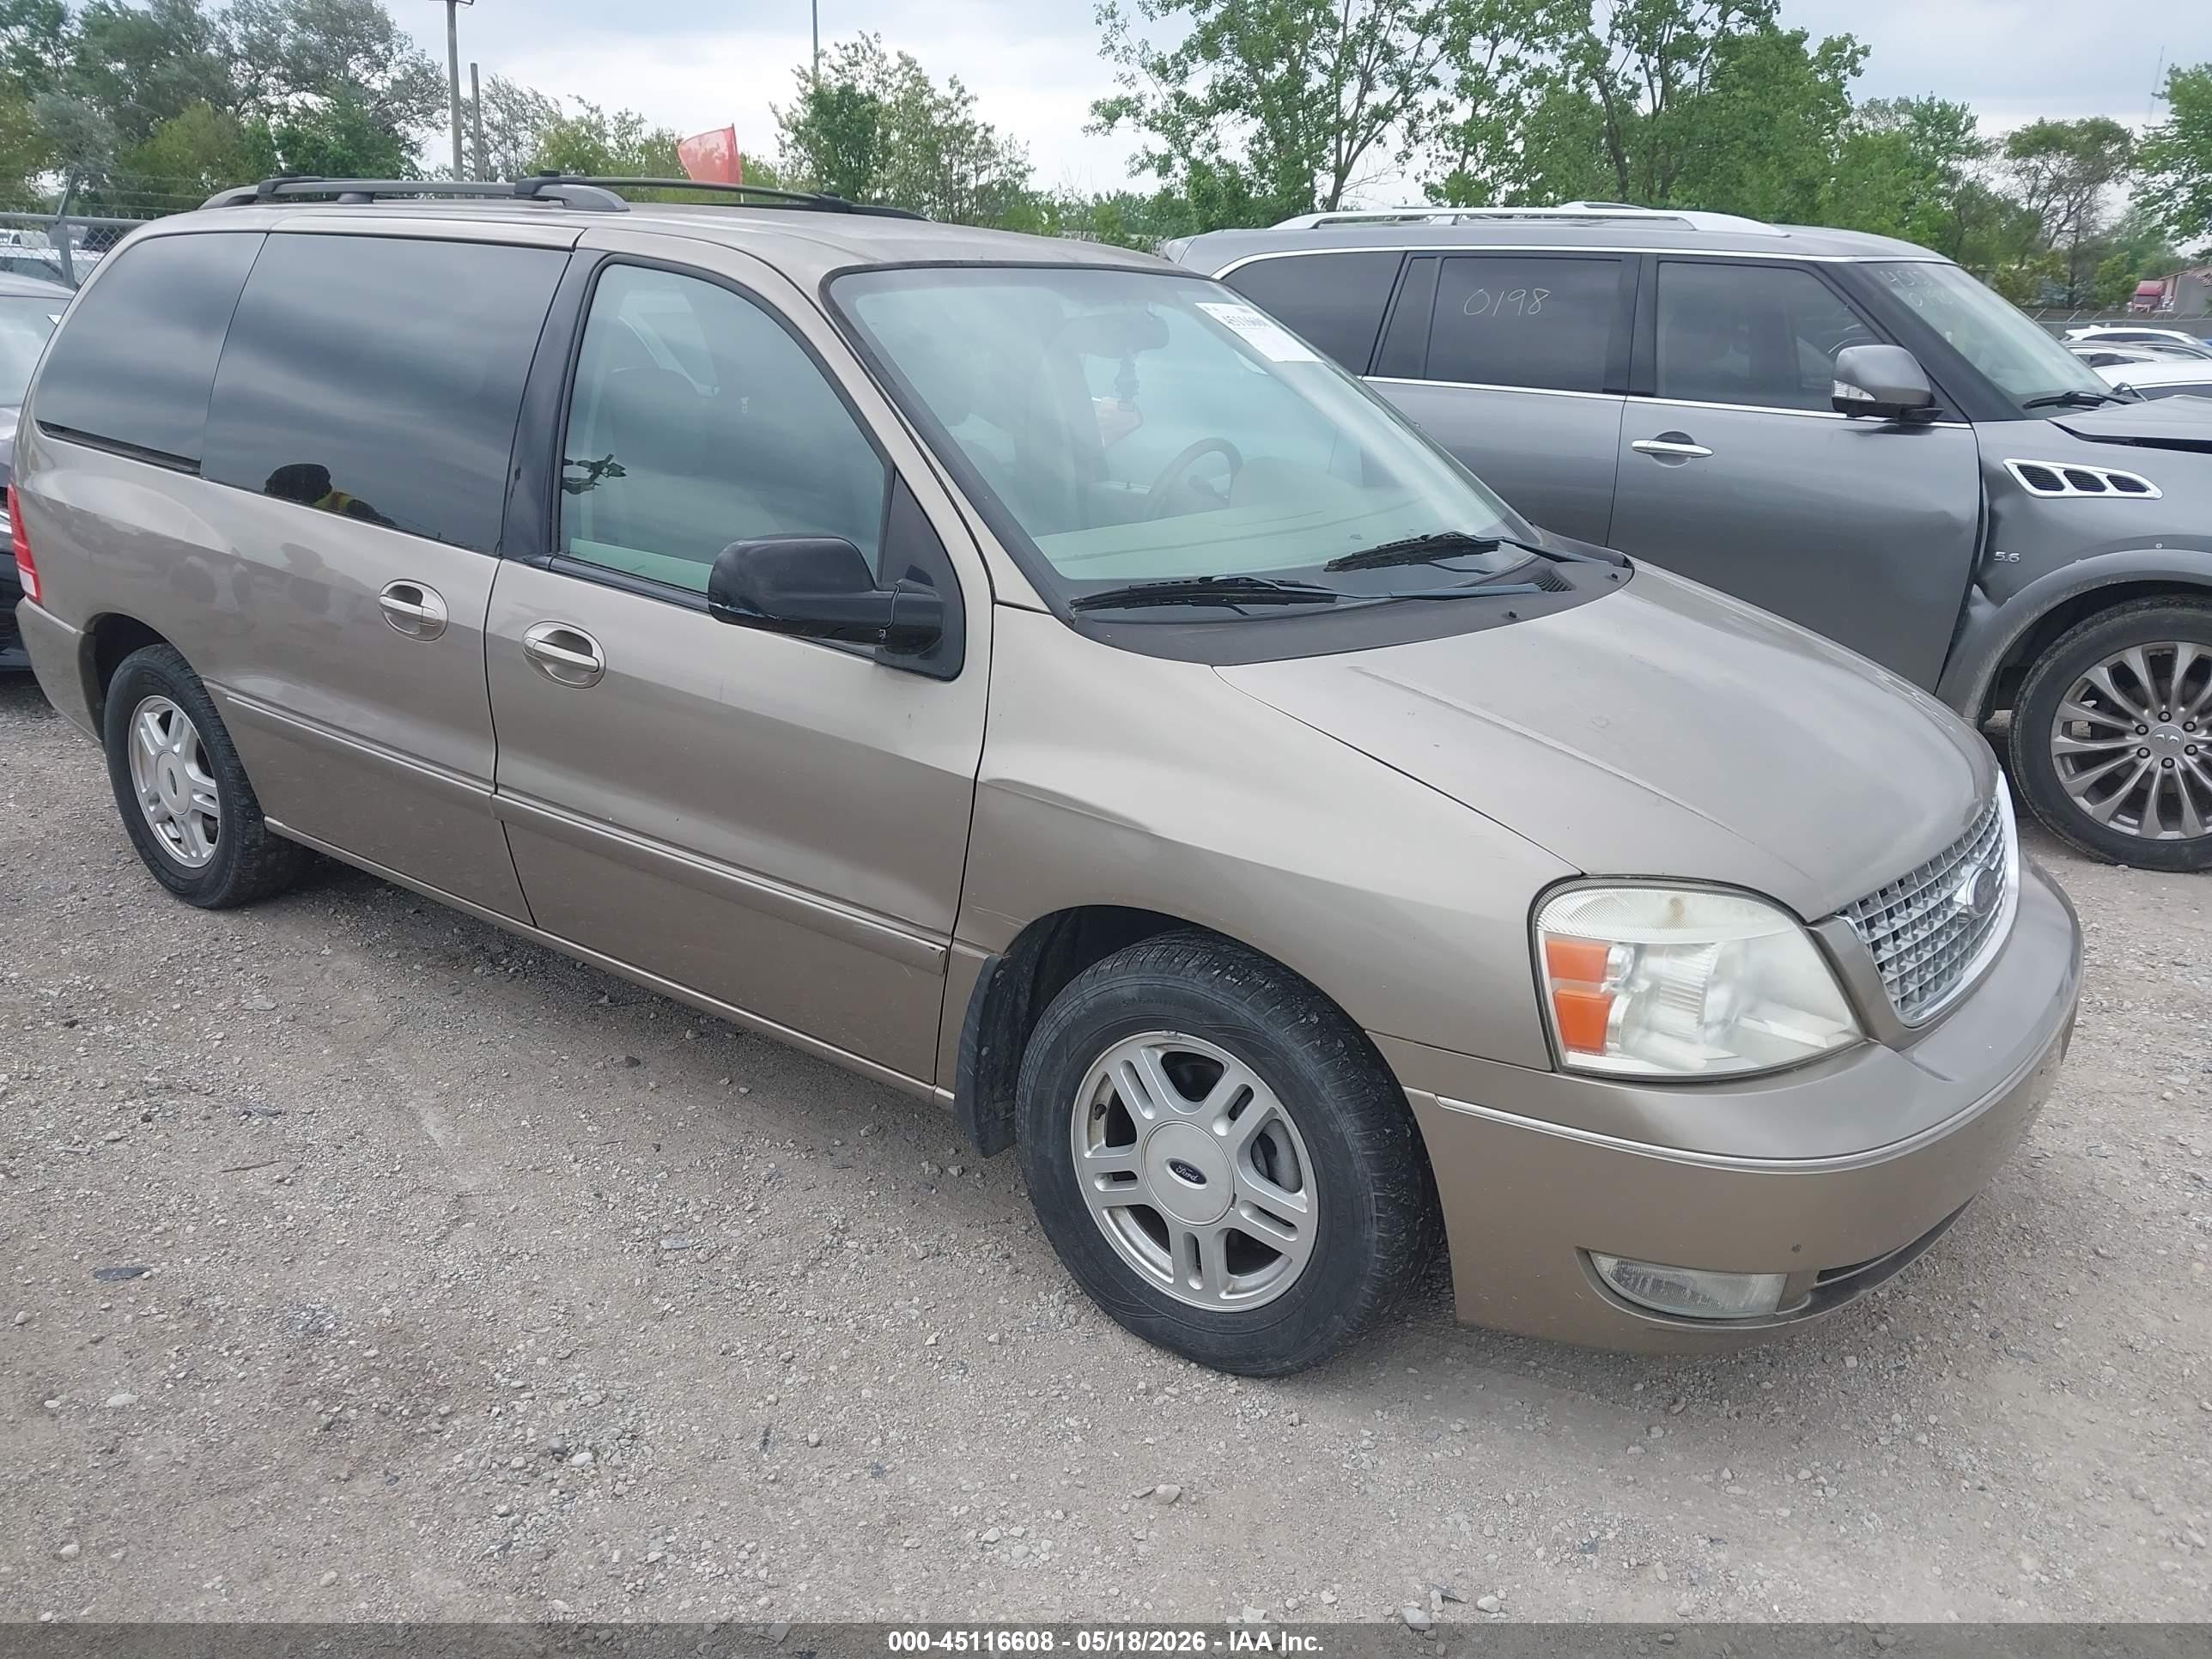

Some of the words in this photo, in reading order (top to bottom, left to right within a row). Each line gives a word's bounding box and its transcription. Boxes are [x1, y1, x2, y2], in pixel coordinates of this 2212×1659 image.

[1463, 288, 1551, 317] 0198
[1993, 550, 2021, 563] 5.6
[1176, 1164, 1199, 1182] Ford
